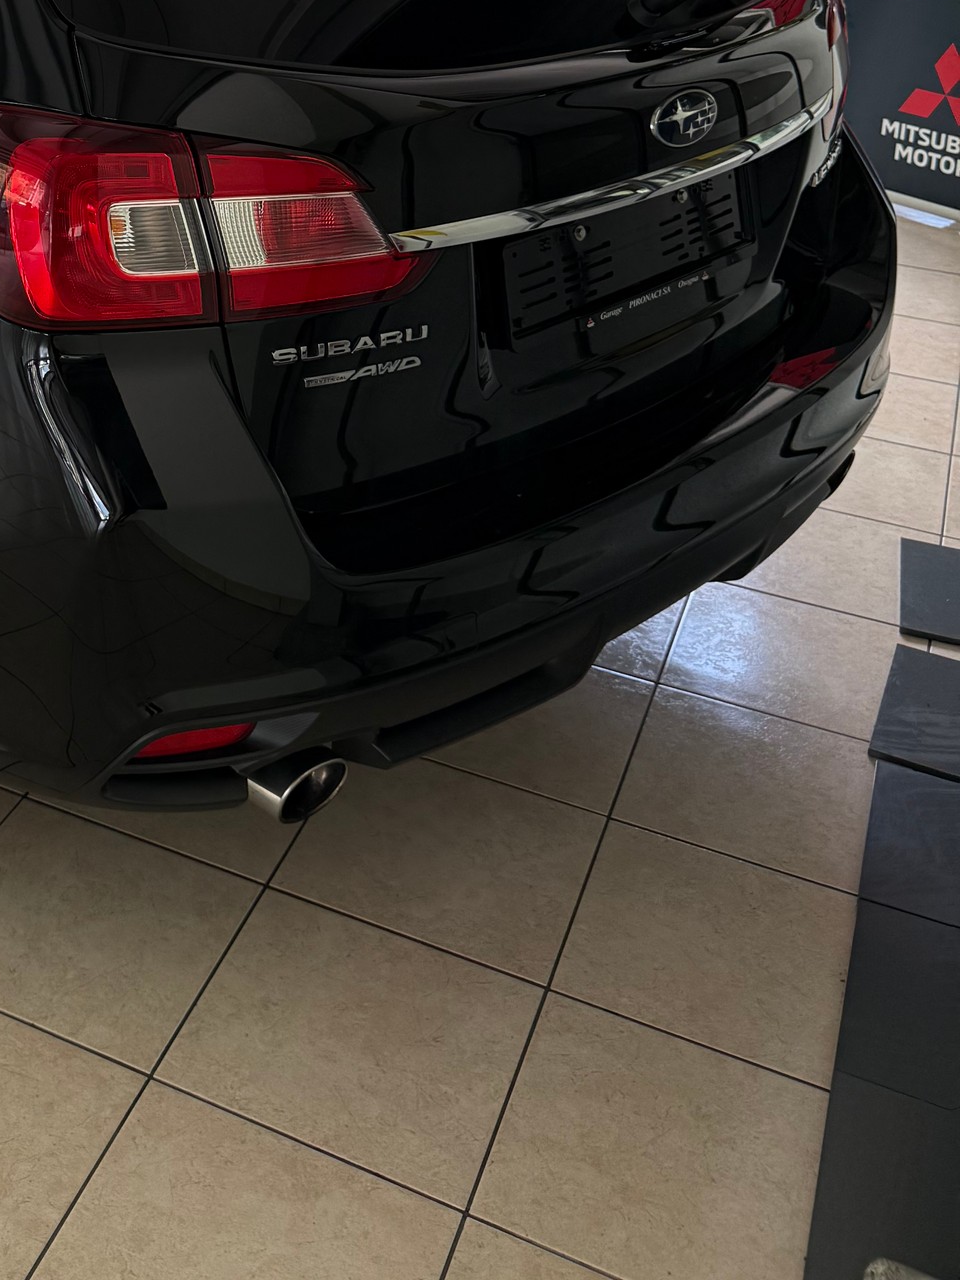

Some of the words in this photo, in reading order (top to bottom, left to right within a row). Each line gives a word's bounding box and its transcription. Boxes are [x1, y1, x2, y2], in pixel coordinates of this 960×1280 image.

[880, 118, 960, 155] MITSUB
[600, 307, 623, 321] Garage
[628, 289, 662, 309] PIRONACI
[662, 285, 672, 295] SA
[271, 324, 429, 366] SUBARU
[349, 356, 422, 381] AWD
